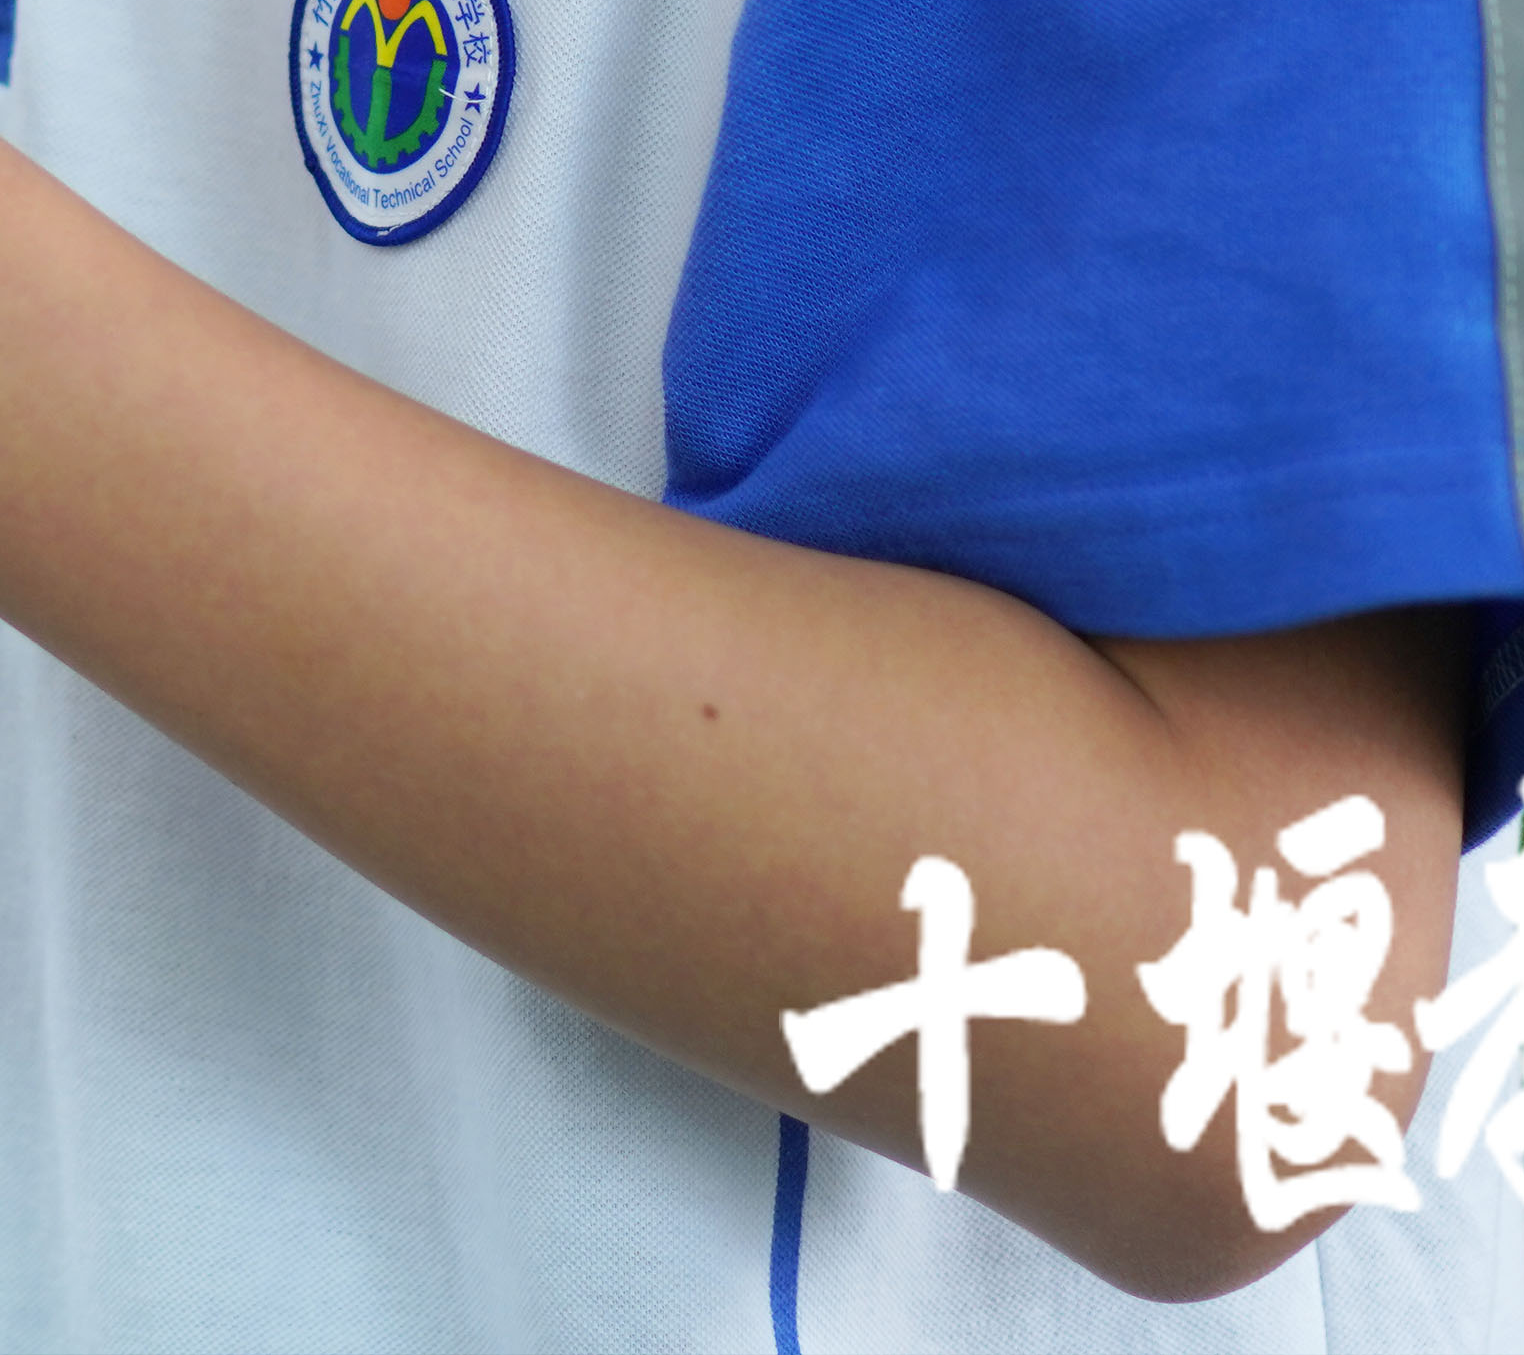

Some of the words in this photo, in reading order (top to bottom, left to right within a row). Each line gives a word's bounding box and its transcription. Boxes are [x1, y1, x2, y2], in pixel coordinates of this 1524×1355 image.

[327, 136, 369, 206] Vocational
[373, 170, 435, 209] Technical
[435, 117, 473, 177] School
